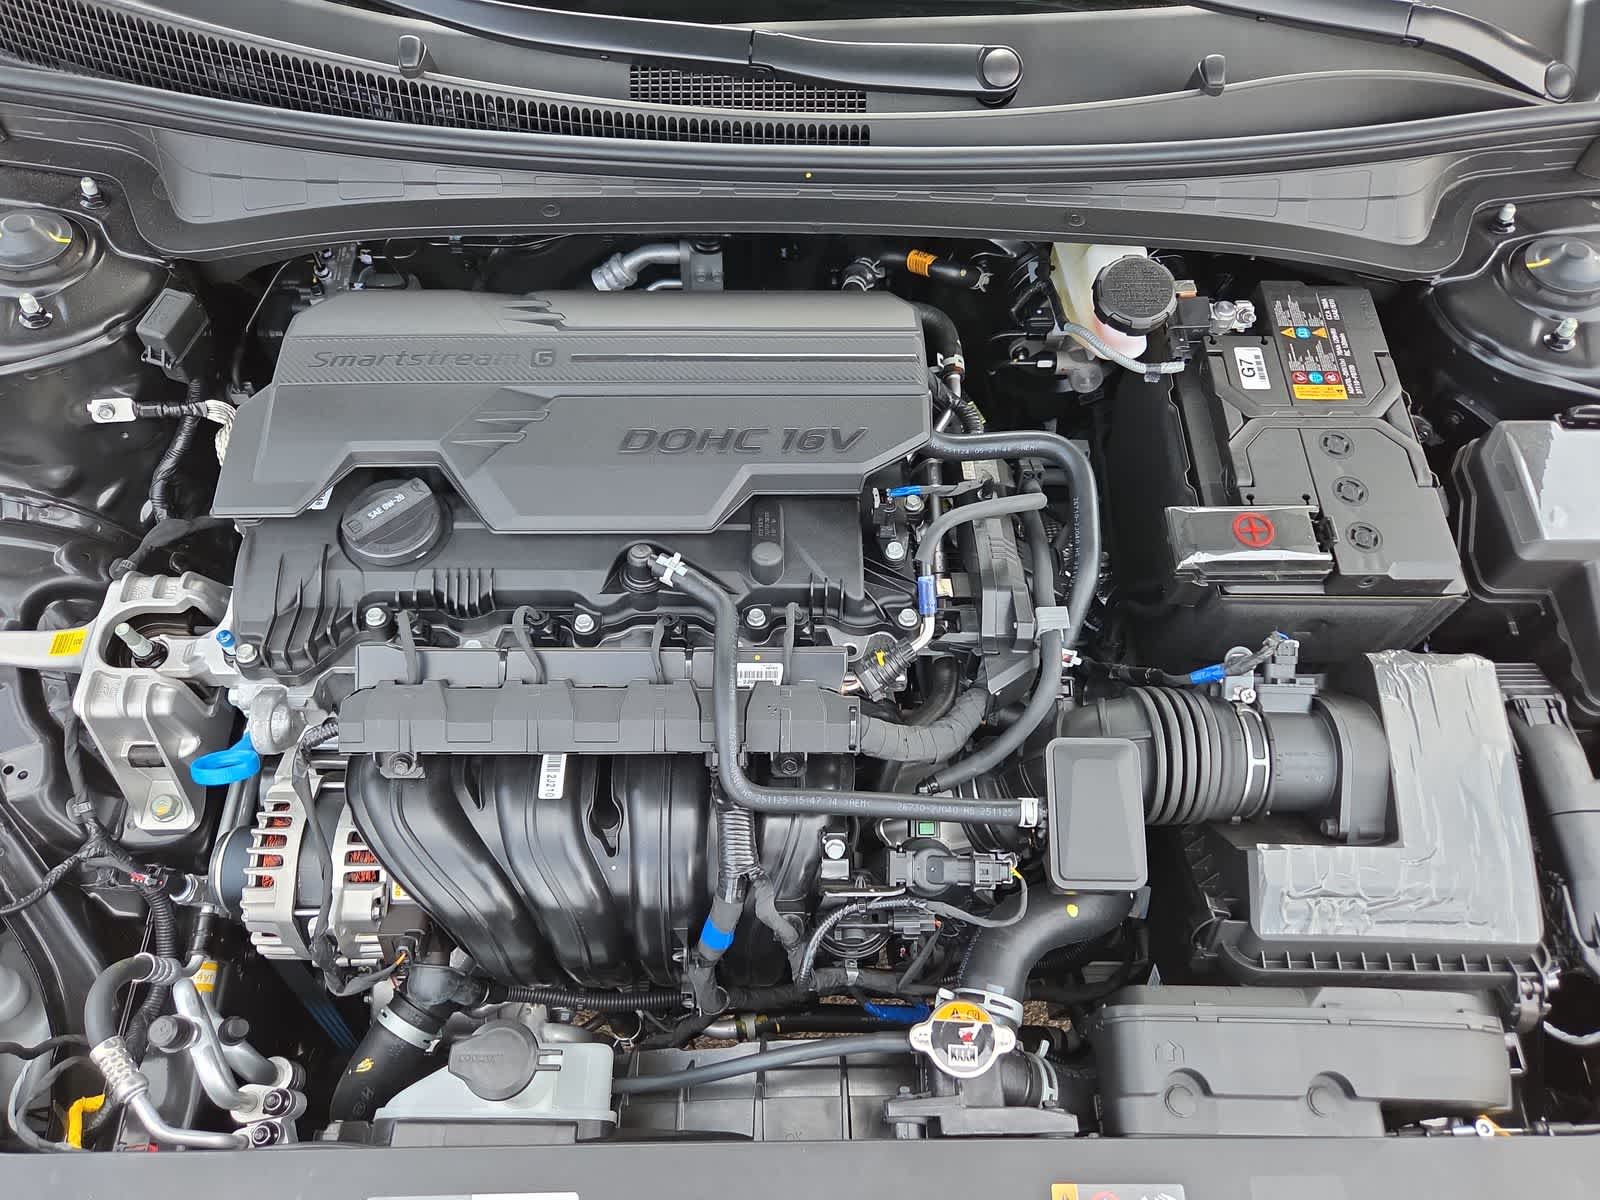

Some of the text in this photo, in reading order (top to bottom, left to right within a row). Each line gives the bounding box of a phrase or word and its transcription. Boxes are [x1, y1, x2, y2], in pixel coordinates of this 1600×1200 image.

[1240, 359, 1256, 378] G7
[617, 426, 868, 454] DOHC 16V
[367, 493, 406, 520] SAE 0W-20
[545, 774, 558, 798] 2J210
